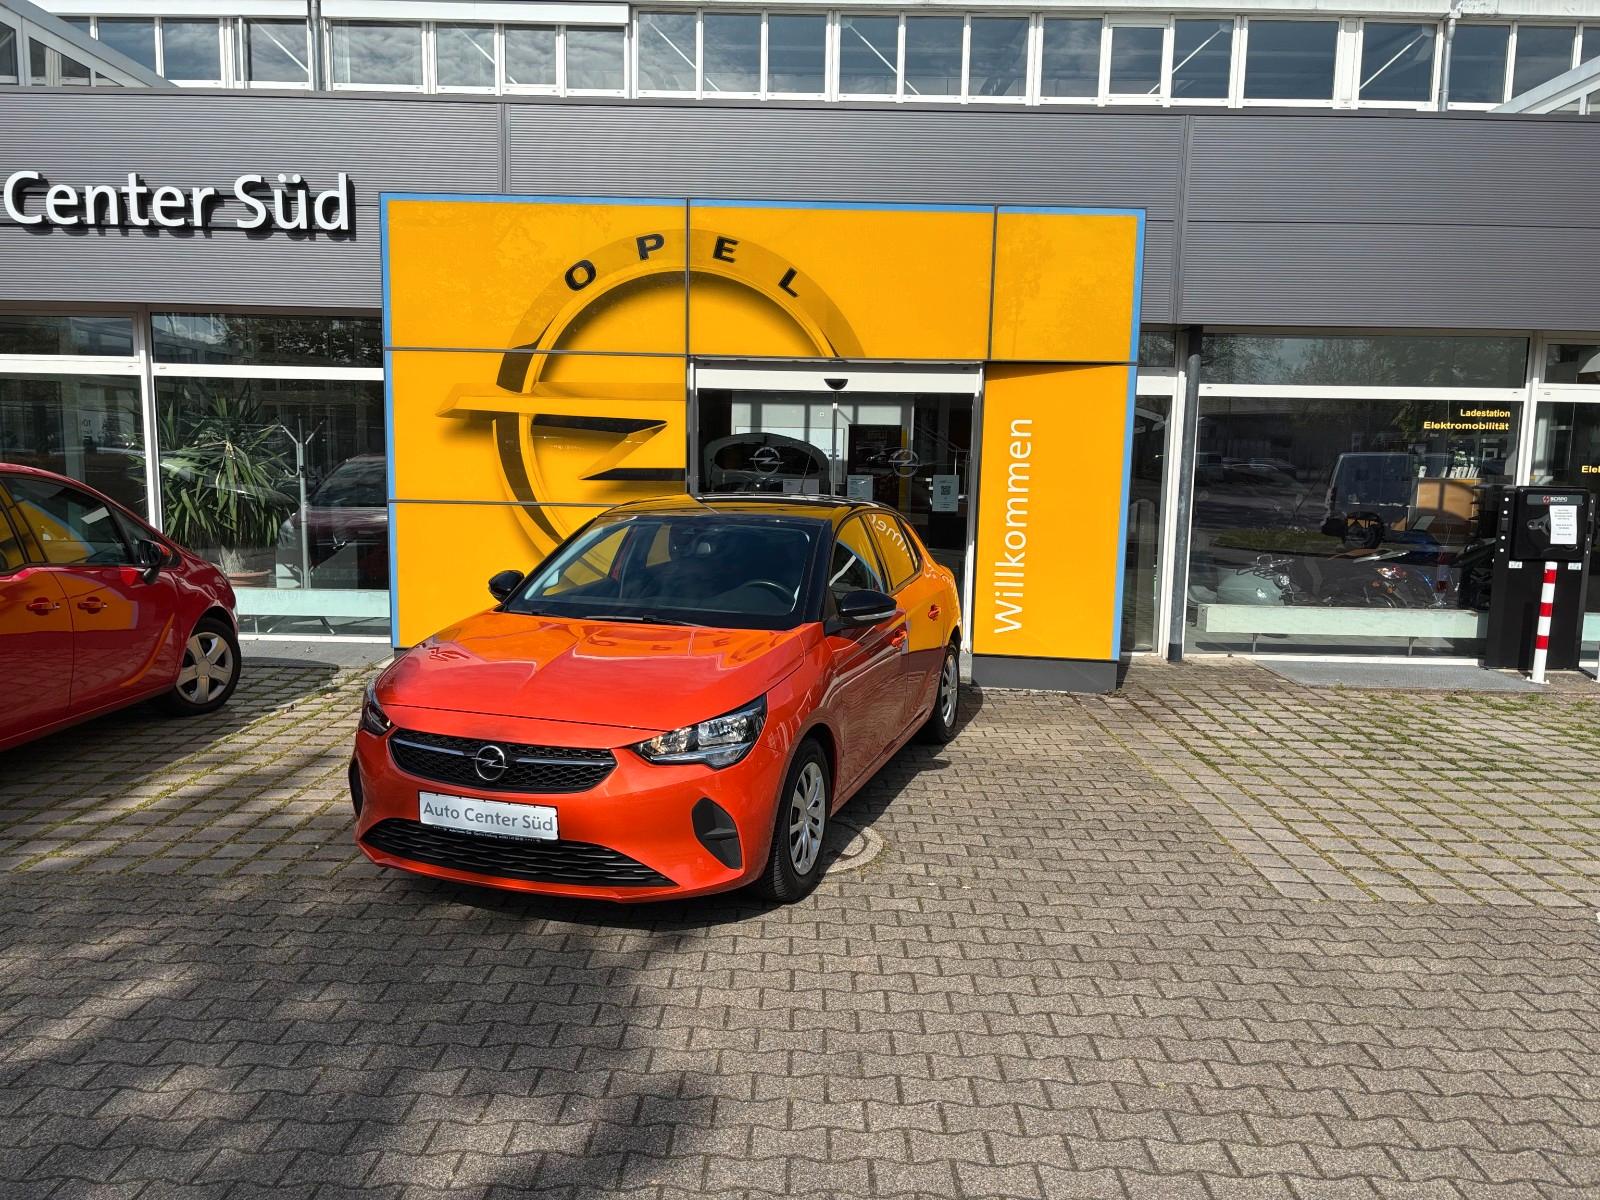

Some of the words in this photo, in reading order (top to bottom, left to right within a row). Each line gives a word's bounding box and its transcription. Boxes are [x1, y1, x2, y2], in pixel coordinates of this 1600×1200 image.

[3, 170, 215, 227] Center
[233, 172, 350, 231] Süd
[564, 233, 803, 299] OPEL
[1423, 421, 1510, 431] Elektromobilität
[1460, 408, 1511, 418] Ladestation
[993, 419, 1033, 634] Willkommen
[423, 801, 460, 820] Auto
[464, 807, 518, 828] Center
[522, 815, 554, 832] Süd
